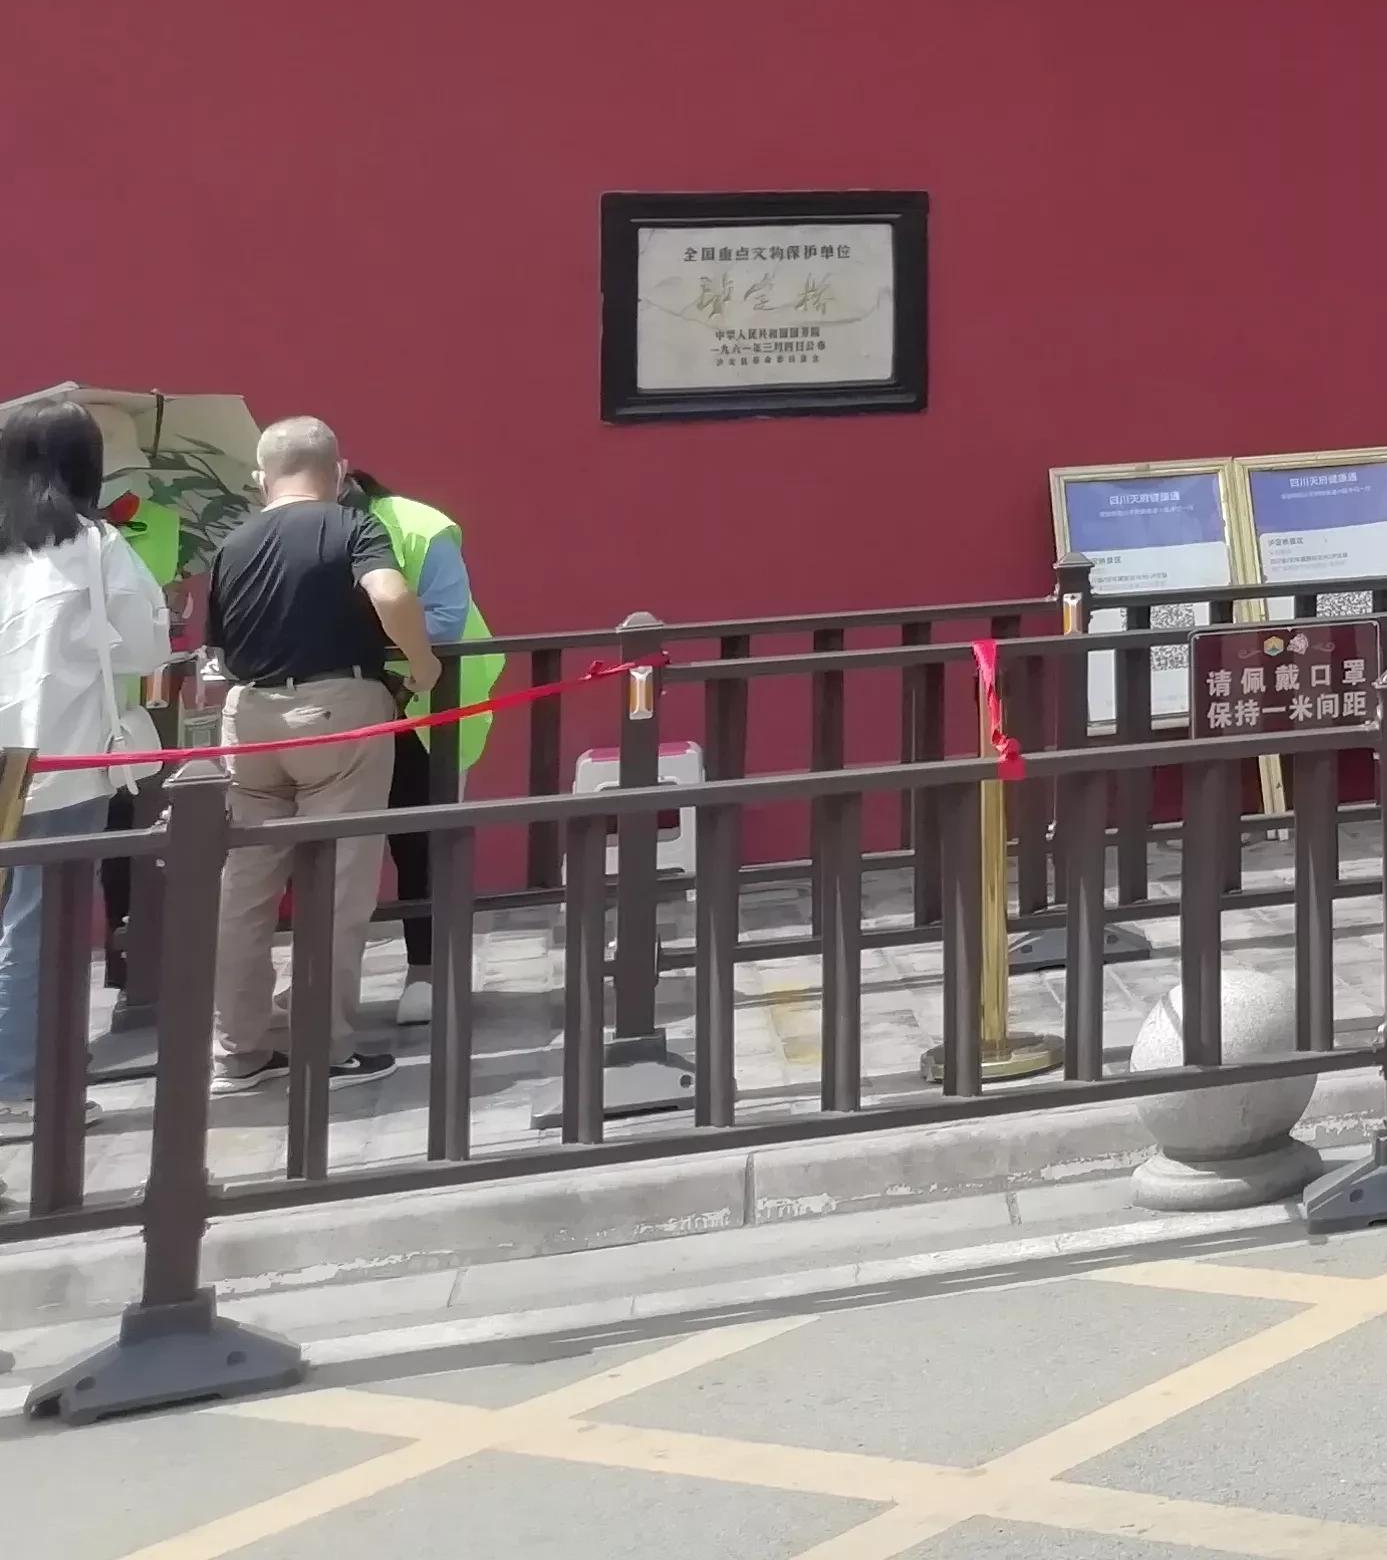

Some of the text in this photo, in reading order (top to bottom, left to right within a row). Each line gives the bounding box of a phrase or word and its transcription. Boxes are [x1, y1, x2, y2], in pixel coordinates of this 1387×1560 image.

[683, 244, 852, 263] 全国重点文物保护单位
[1206, 659, 1367, 698] 请佩戴口罩
[1206, 690, 1368, 729] 保持一米间距
